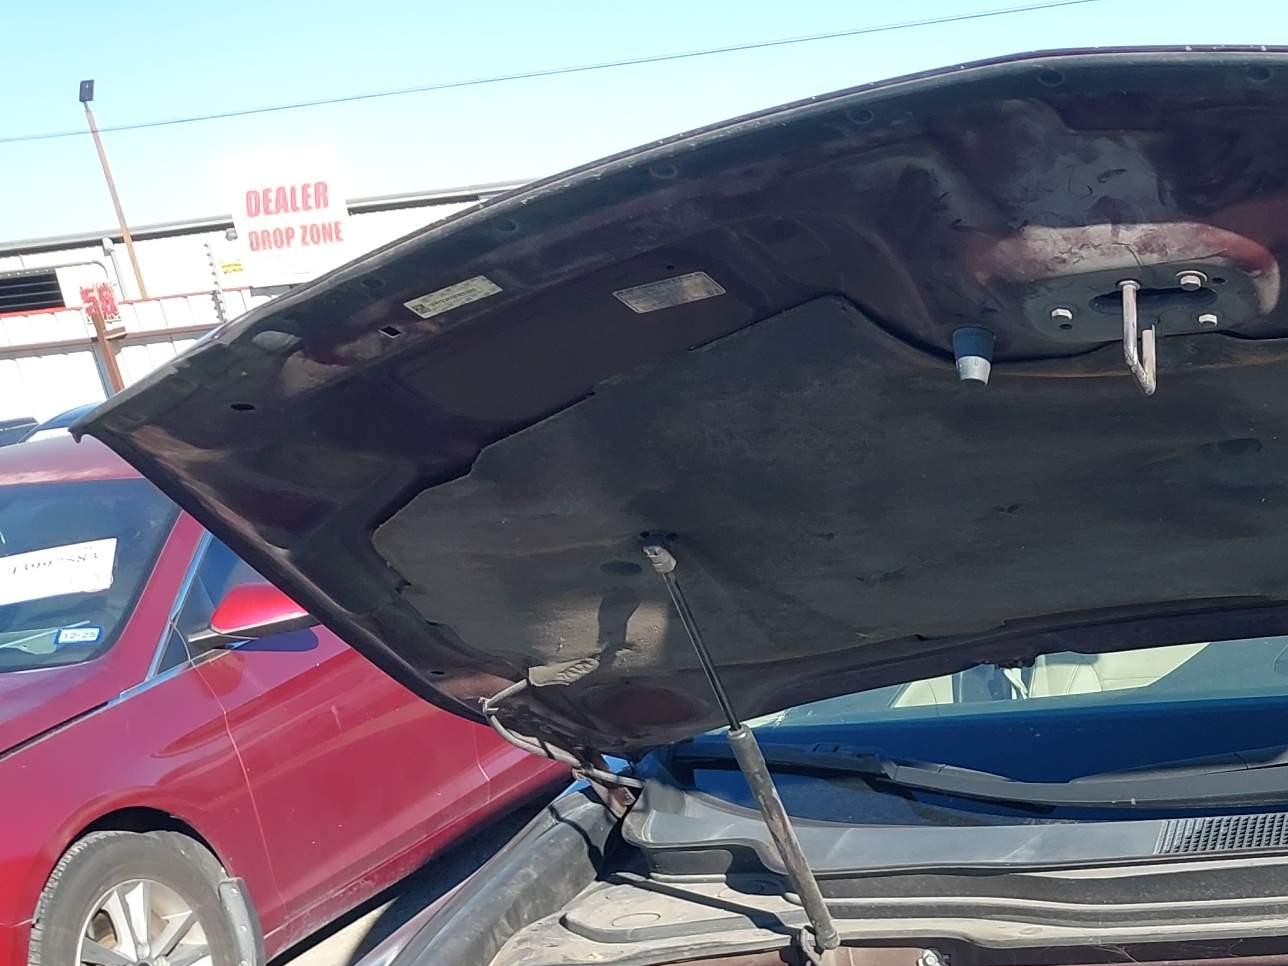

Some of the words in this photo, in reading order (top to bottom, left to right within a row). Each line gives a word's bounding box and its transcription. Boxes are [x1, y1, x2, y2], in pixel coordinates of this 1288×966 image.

[246, 181, 329, 218] DEALER
[248, 226, 295, 252] DROP
[300, 221, 344, 247] ZONE
